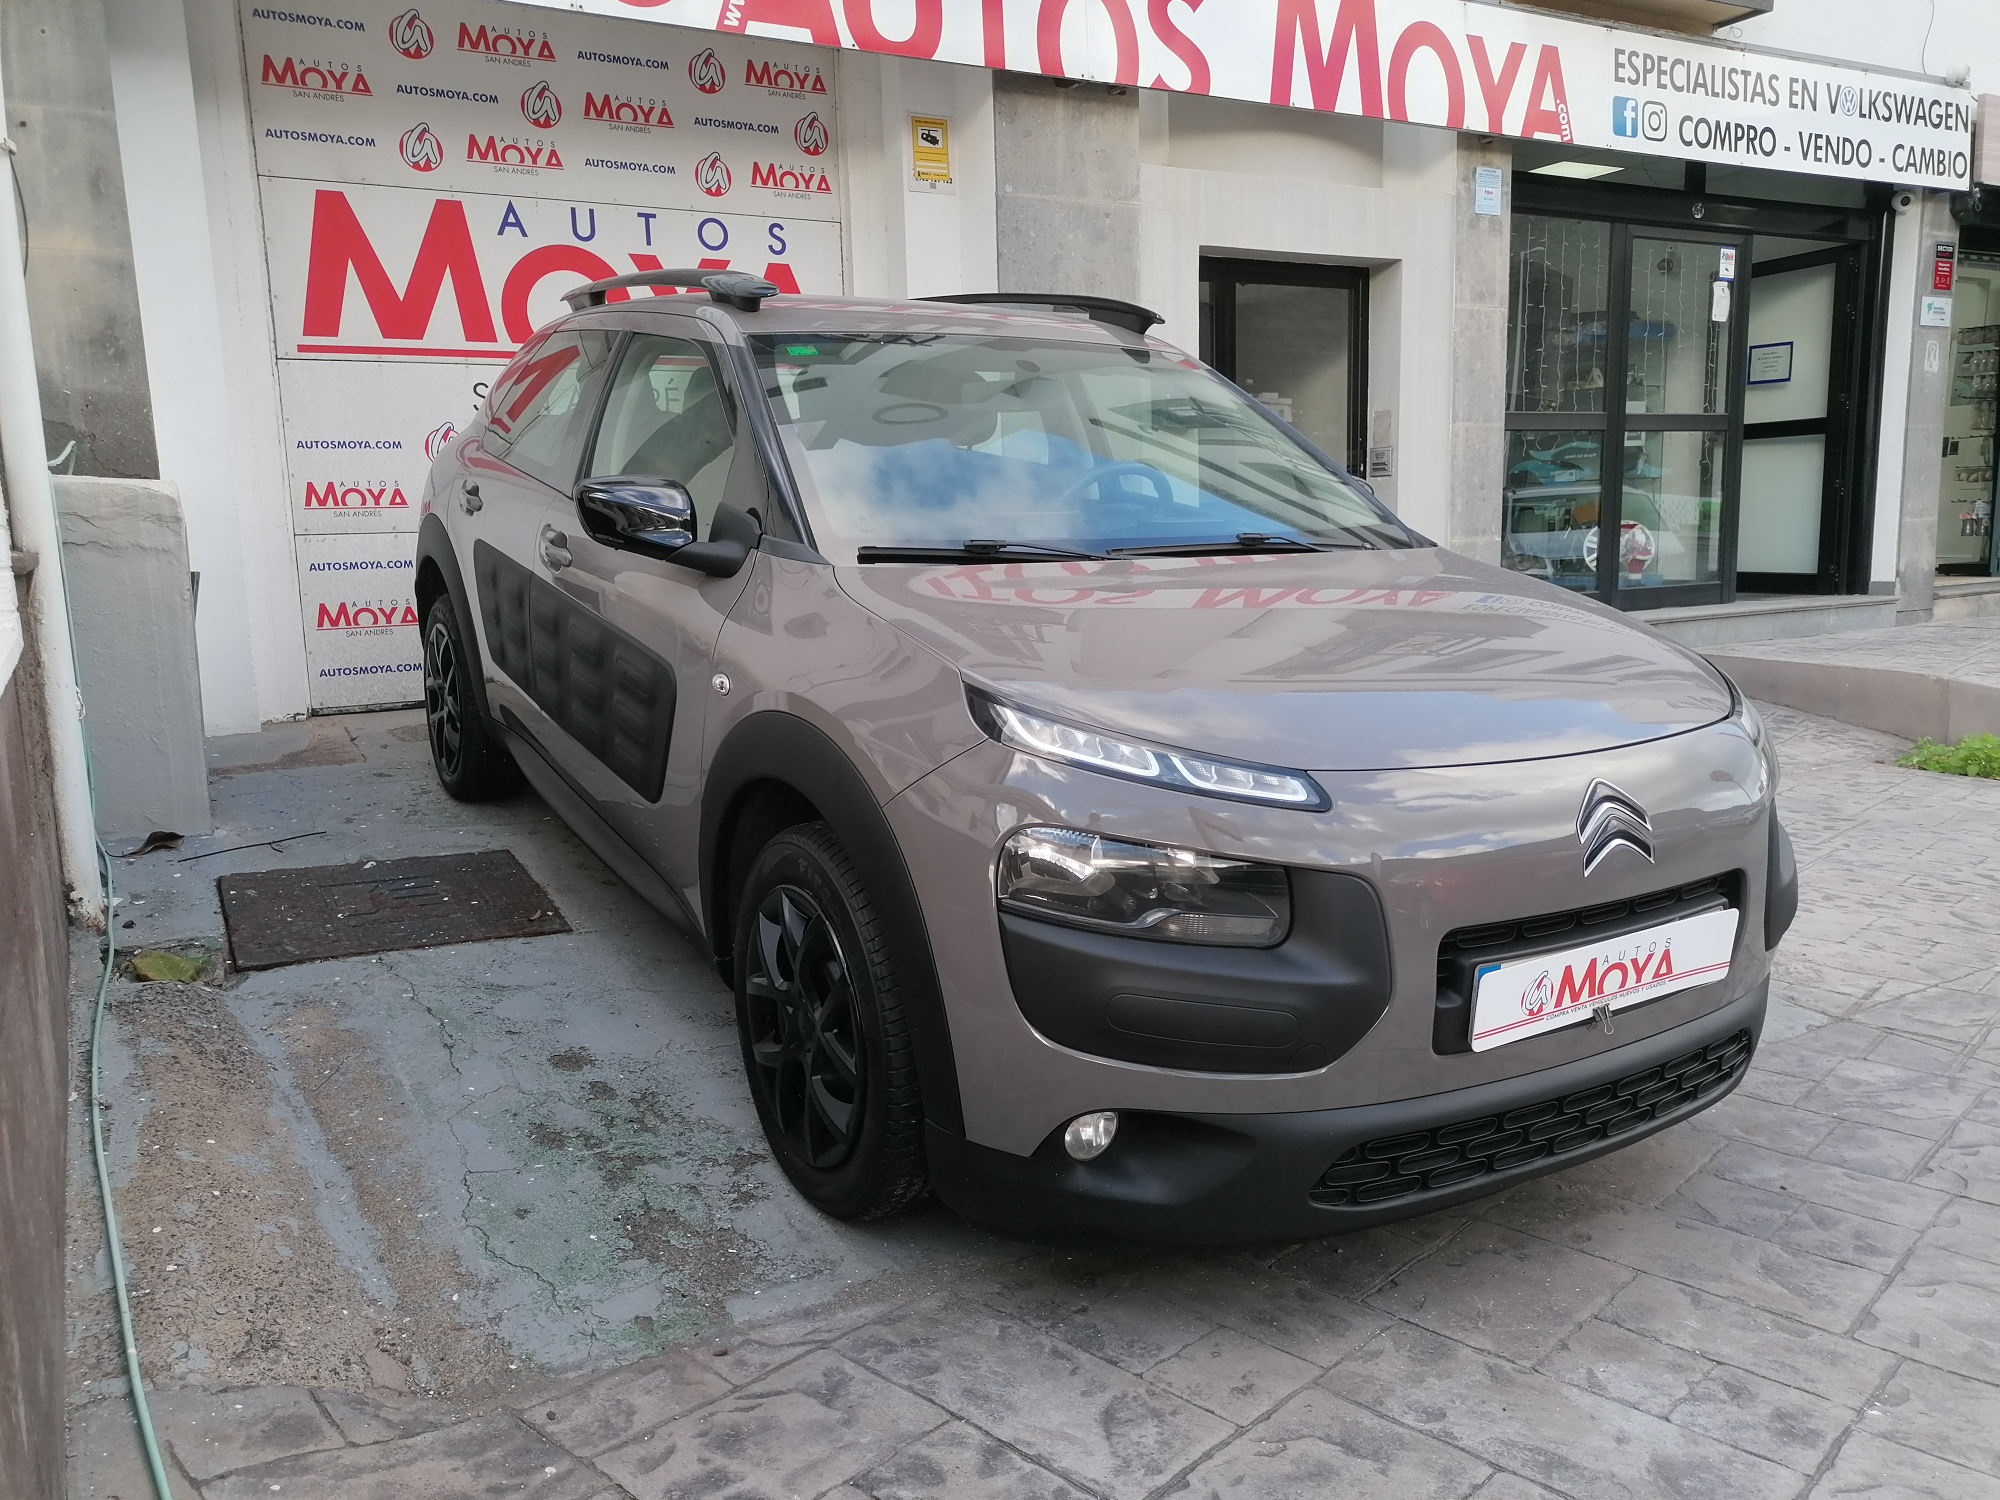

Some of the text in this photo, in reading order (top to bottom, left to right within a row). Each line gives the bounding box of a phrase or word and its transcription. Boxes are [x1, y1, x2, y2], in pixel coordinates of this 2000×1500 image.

[252, 8, 366, 32] AUTOSMOYA.COM
[458, 22, 556, 59] MOYA
[491, 26, 547, 39] AUTOS
[299, 58, 362, 73] AUTOS
[485, 56, 501, 64] SAN
[577, 51, 669, 70] AUTOSMOYA.COM
[773, 62, 820, 74] AUTOS
[262, 54, 372, 93] MOYA
[745, 59, 827, 92] MOYA
[1270, 0, 1574, 144] MOYA
[1614, 47, 1780, 107] ESPECIALISTAS
[1788, 76, 1818, 112] EN
[293, 90, 310, 99] SAN
[396, 84, 499, 104] AUTOSMOYA.COM
[615, 95, 666, 107] AUTOS
[584, 92, 674, 125] MOYA
[694, 117, 779, 134] AUTOSMOYA.COM
[1556, 99, 1571, 141] .com
[265, 128, 376, 147] AUTOSMOYA.COM
[500, 136, 555, 148] AUTOS
[1679, 115, 1777, 157] COMPRO
[1798, 131, 1872, 168] VENDO
[1892, 143, 1968, 179] CAMBIO
[467, 134, 564, 167] MOYA
[493, 166, 510, 174] SAN
[585, 158, 676, 174] AUTOSMOYA.COM
[779, 163, 825, 174] AUTOS
[751, 162, 831, 191] MOYA
[497, 200, 788, 256] AUTOS
[303, 189, 803, 341] MO
[296, 440, 402, 449] AUTOSMOYA.COM
[305, 481, 408, 507] MOYA
[340, 480, 399, 488] AUTOS
[309, 560, 413, 572] AUTOSMOYA.COM
[352, 599, 410, 608] AUTOS
[317, 602, 419, 628] MOYA
[319, 663, 423, 677] AUTOSMOYA.COM
[1602, 938, 1672, 966] AUTOS
[1554, 948, 1673, 1009] MOYA
[1546, 1009, 1569, 1020] COMPRA
[1571, 1003, 1588, 1013] VENTA
[1619, 988, 1640, 998] NUEVOS
[1645, 980, 1667, 991] USADOS
